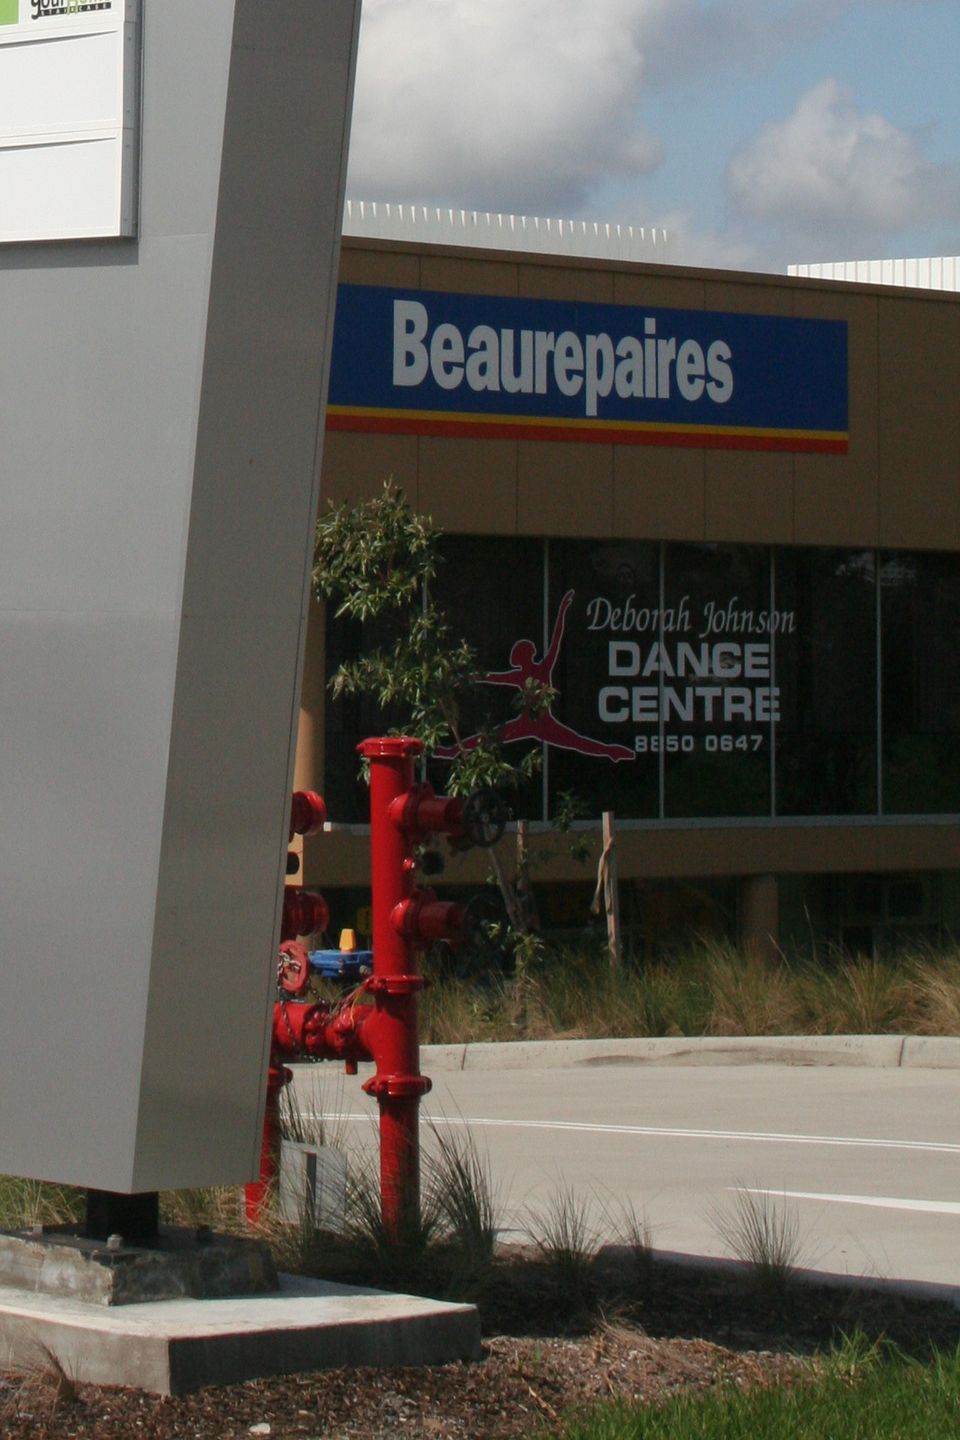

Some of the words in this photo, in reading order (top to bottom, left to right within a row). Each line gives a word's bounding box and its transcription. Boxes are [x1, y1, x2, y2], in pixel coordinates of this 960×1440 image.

[392, 299, 734, 416] Beaurepaires
[586, 594, 692, 633] Deborah
[699, 596, 796, 638] Johnson
[608, 640, 770, 678] DANCE
[598, 686, 781, 722] CENTRE
[634, 735, 695, 752] 8850
[705, 735, 763, 752] 0647
